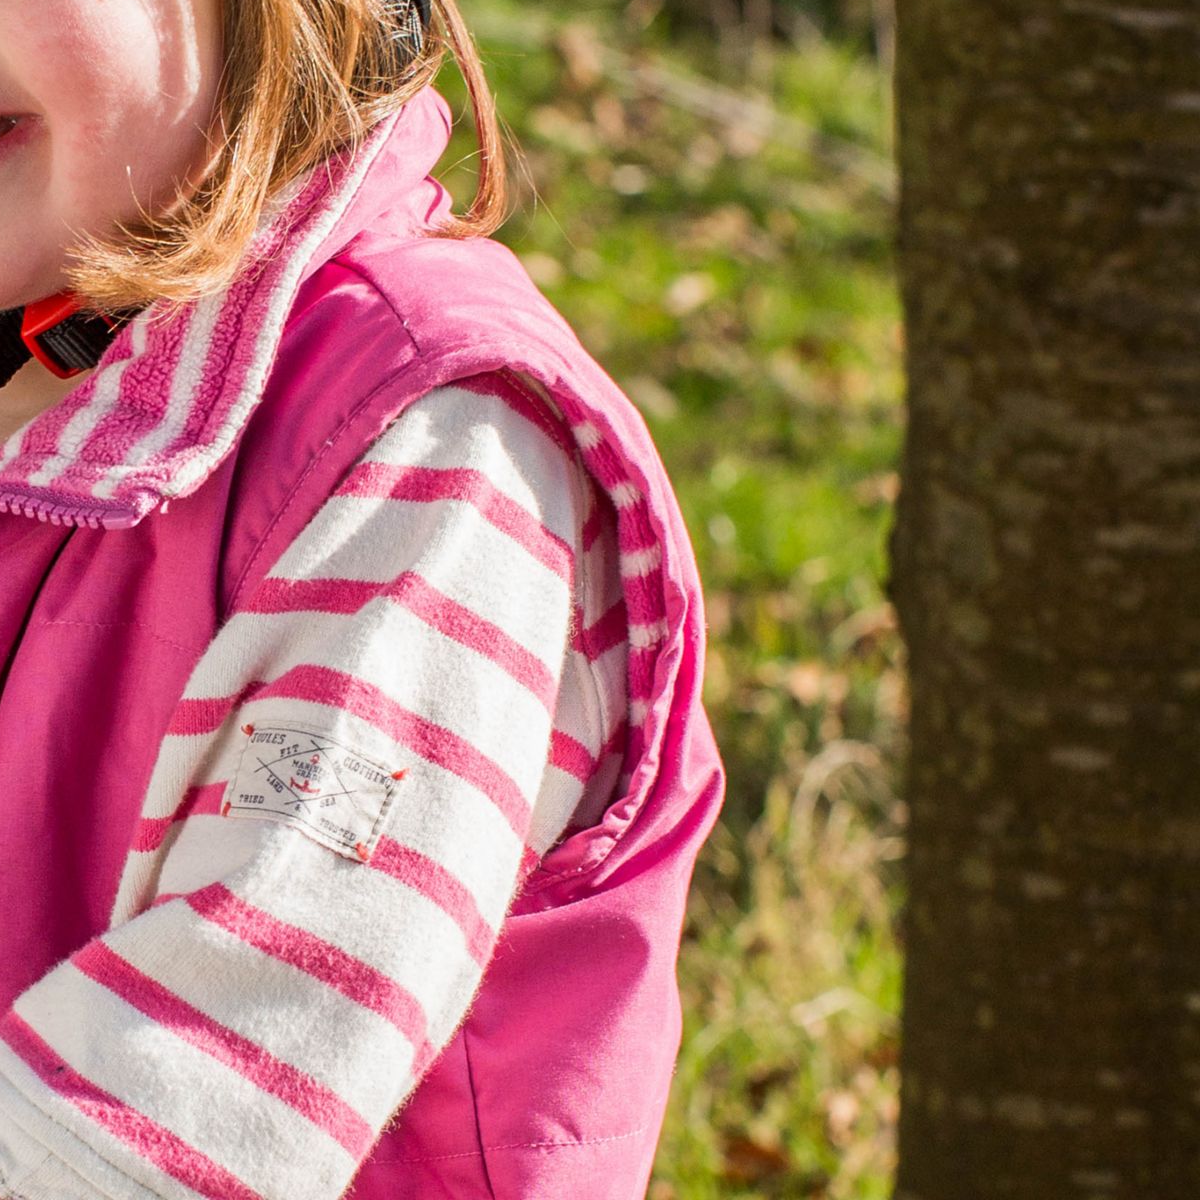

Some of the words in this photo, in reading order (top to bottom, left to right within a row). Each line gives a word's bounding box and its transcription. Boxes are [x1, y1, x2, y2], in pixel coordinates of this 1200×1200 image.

[250, 732, 287, 745] JOULES
[280, 744, 300, 757] FIT
[343, 757, 394, 789] CLOTHING
[239, 794, 265, 805] TRIED
